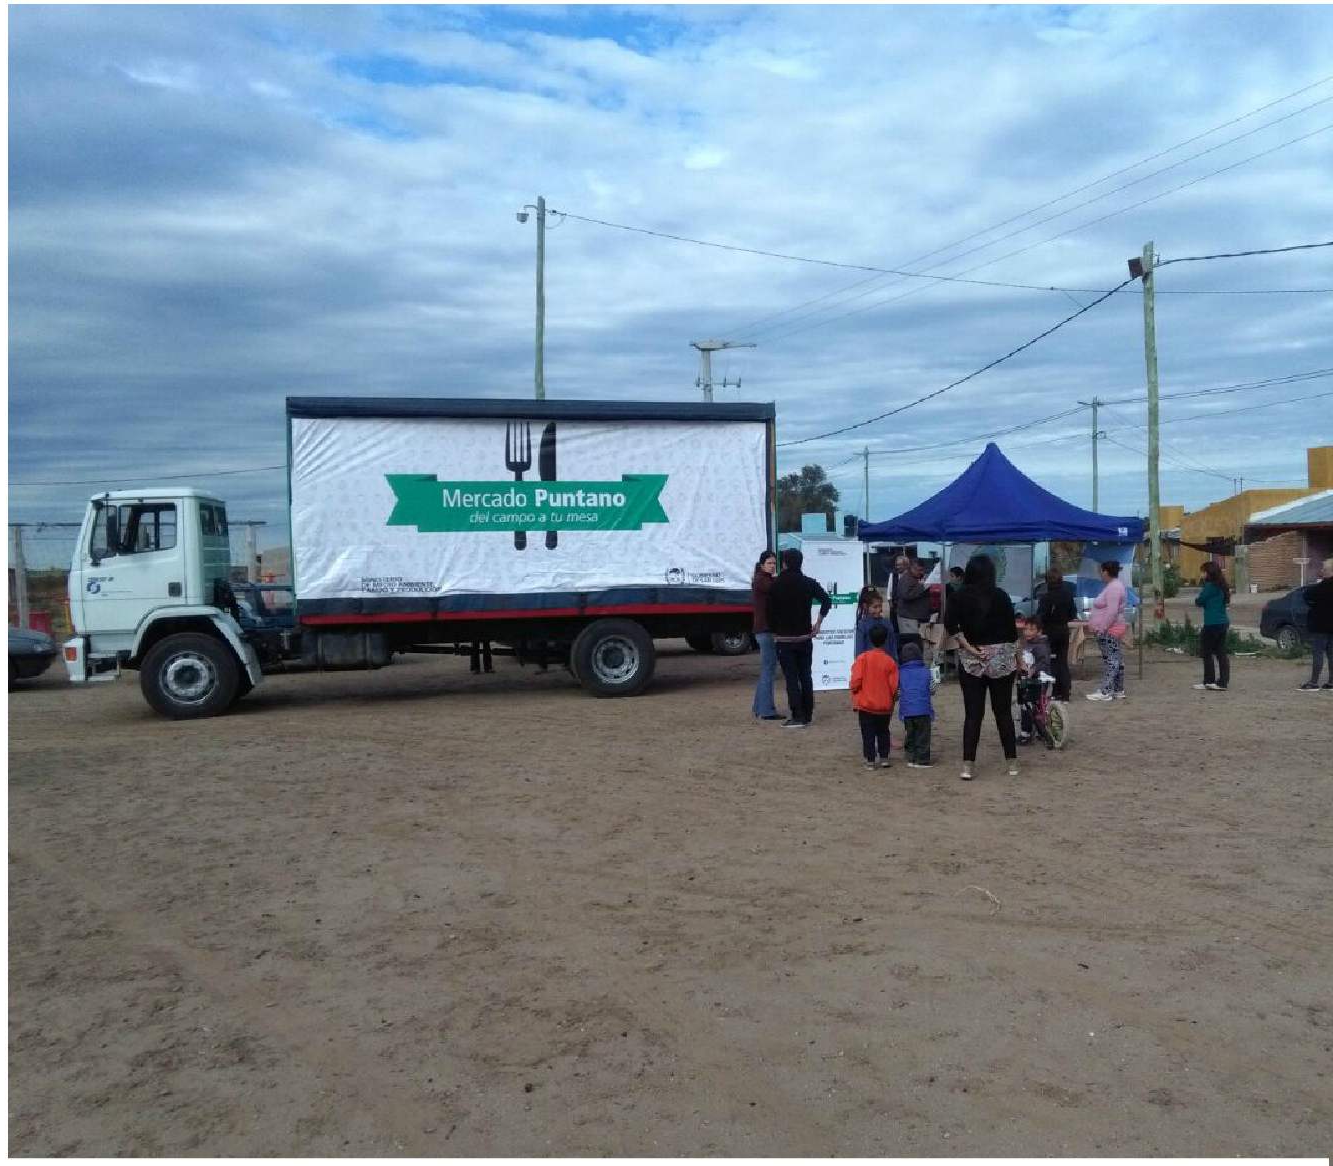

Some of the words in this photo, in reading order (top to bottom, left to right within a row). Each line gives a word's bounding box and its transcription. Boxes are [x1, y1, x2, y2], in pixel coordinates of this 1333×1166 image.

[442, 487, 527, 508] Mercado
[534, 488, 627, 508] Puntano
[469, 511, 490, 524] del
[492, 513, 536, 526] campo
[538, 513, 547, 523] a
[550, 512, 562, 523] tu
[566, 513, 599, 523] mesa
